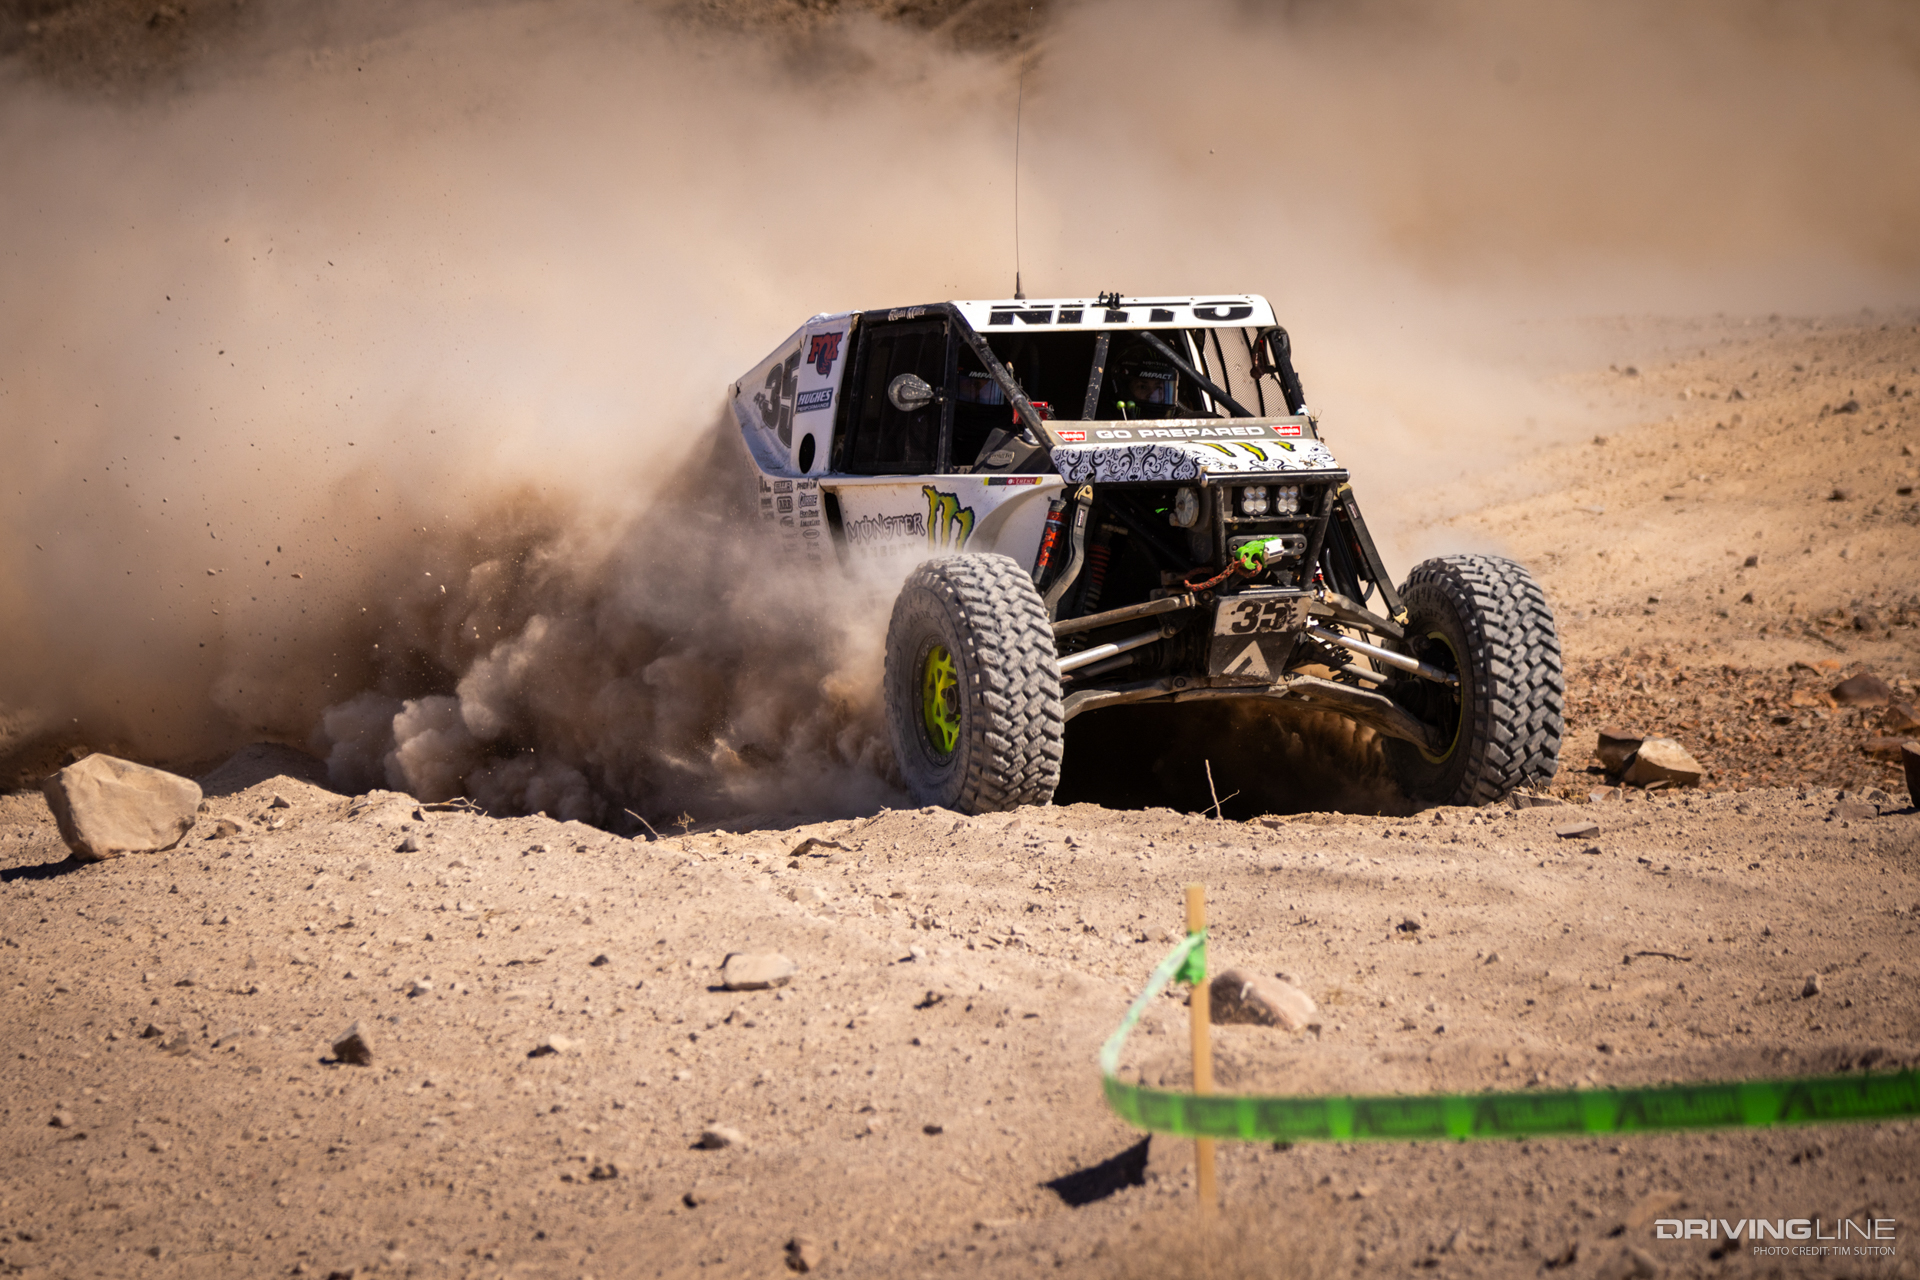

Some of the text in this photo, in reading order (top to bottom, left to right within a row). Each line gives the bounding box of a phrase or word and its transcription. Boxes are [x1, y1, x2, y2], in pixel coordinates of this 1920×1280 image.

[988, 301, 1254, 325] NITTO
[807, 332, 843, 365] FOX
[968, 371, 994, 379] IMPA
[1139, 370, 1172, 381] IMPACT
[798, 388, 832, 406] HUGHES
[797, 402, 829, 413] PERFORMANCE
[1060, 432, 1086, 441] WARN
[1095, 426, 1266, 439] GO PREPARED
[1275, 426, 1301, 436] WARN
[846, 513, 925, 545] MONSTER
[1231, 600, 1288, 633] 35
